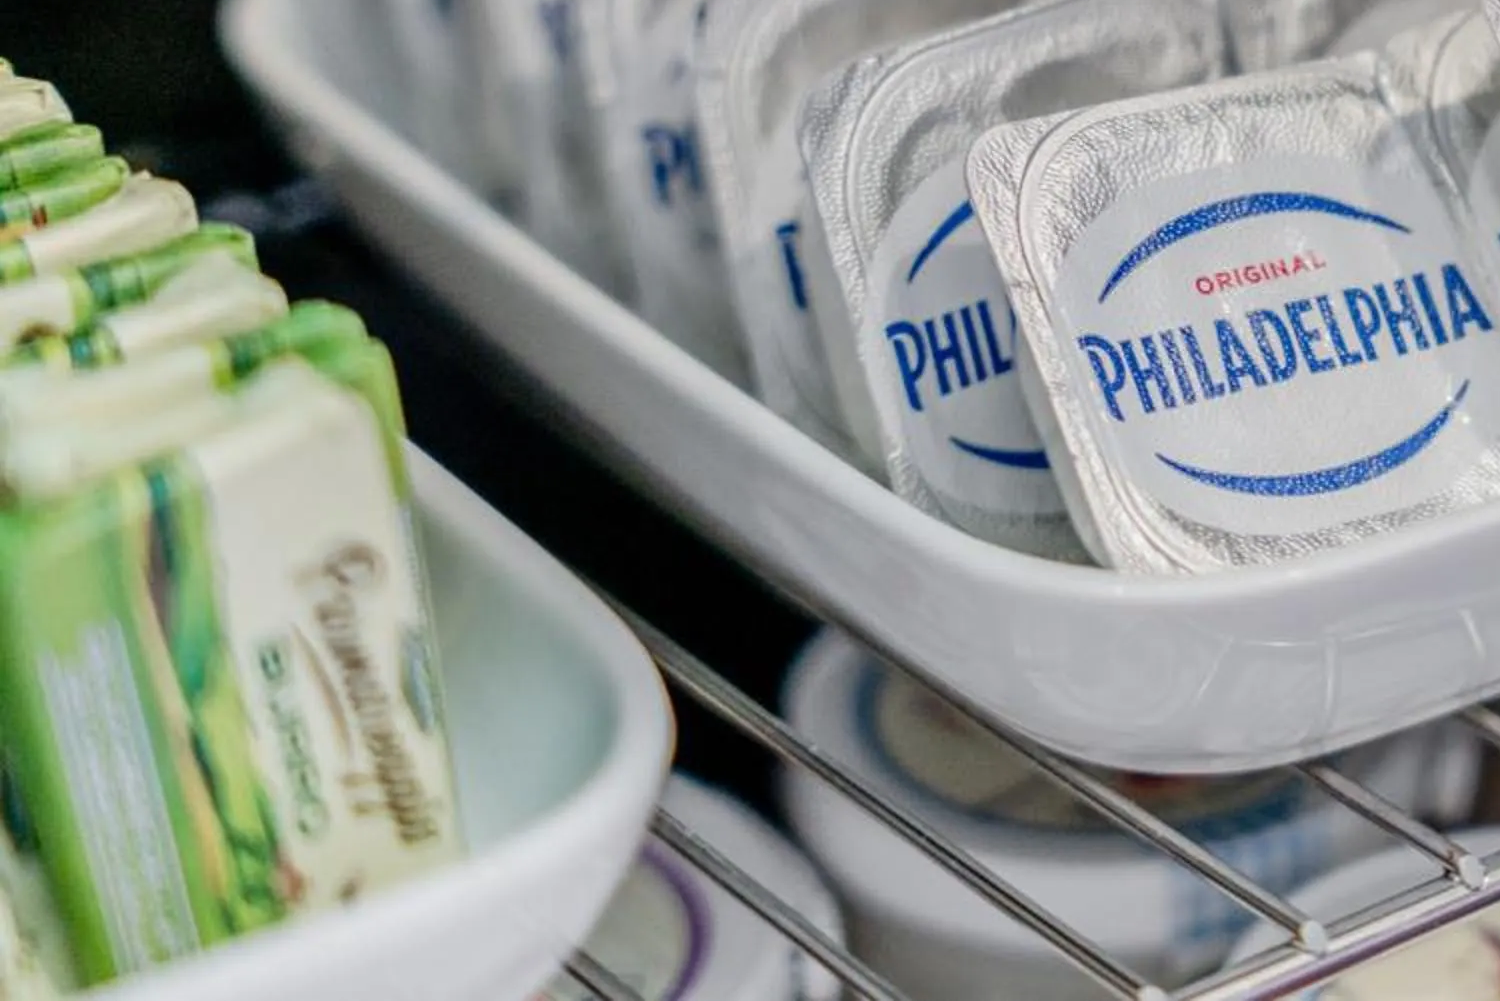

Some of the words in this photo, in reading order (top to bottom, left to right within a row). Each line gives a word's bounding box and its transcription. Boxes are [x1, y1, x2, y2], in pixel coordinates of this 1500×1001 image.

[1195, 259, 1327, 294] ORIGINAL
[886, 300, 1018, 412] PHIL
[1077, 262, 1493, 423] PHILADELPHIA
